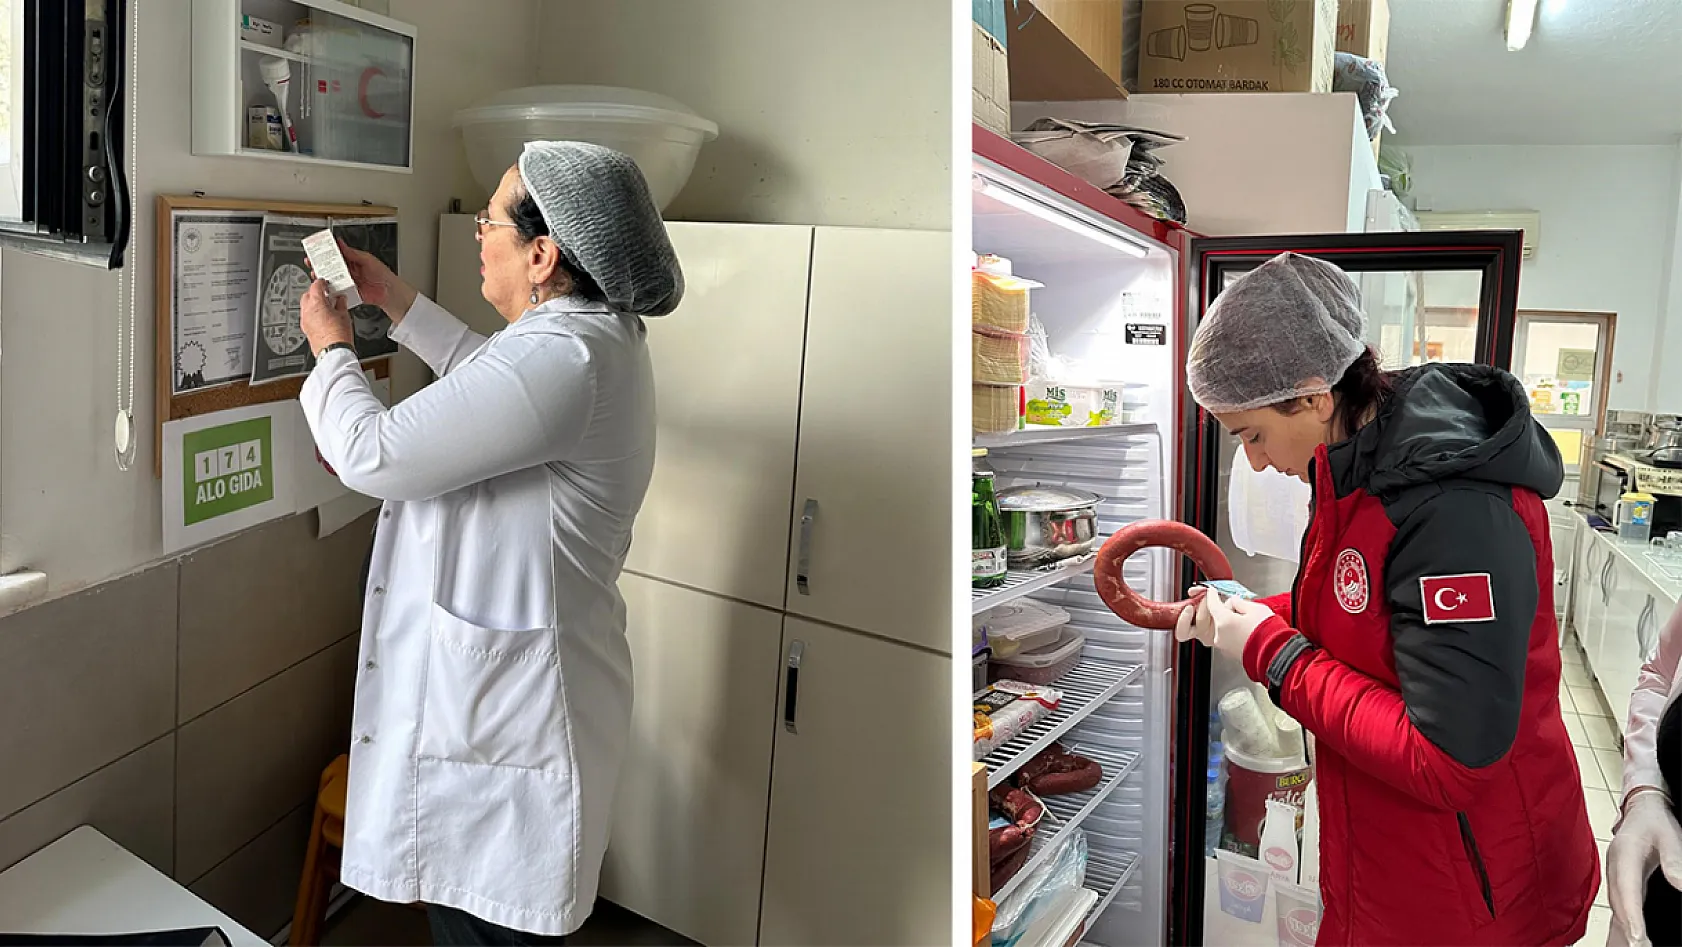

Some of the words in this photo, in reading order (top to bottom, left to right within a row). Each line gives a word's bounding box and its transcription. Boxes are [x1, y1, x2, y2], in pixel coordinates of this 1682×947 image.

[1153, 78, 1170, 88] 180
[1172, 78, 1184, 88] CC
[1186, 78, 1227, 89] OTOMAT
[1229, 79, 1269, 90] BARDAK
[196, 479, 226, 504] ALO
[229, 469, 263, 494] GIDA
